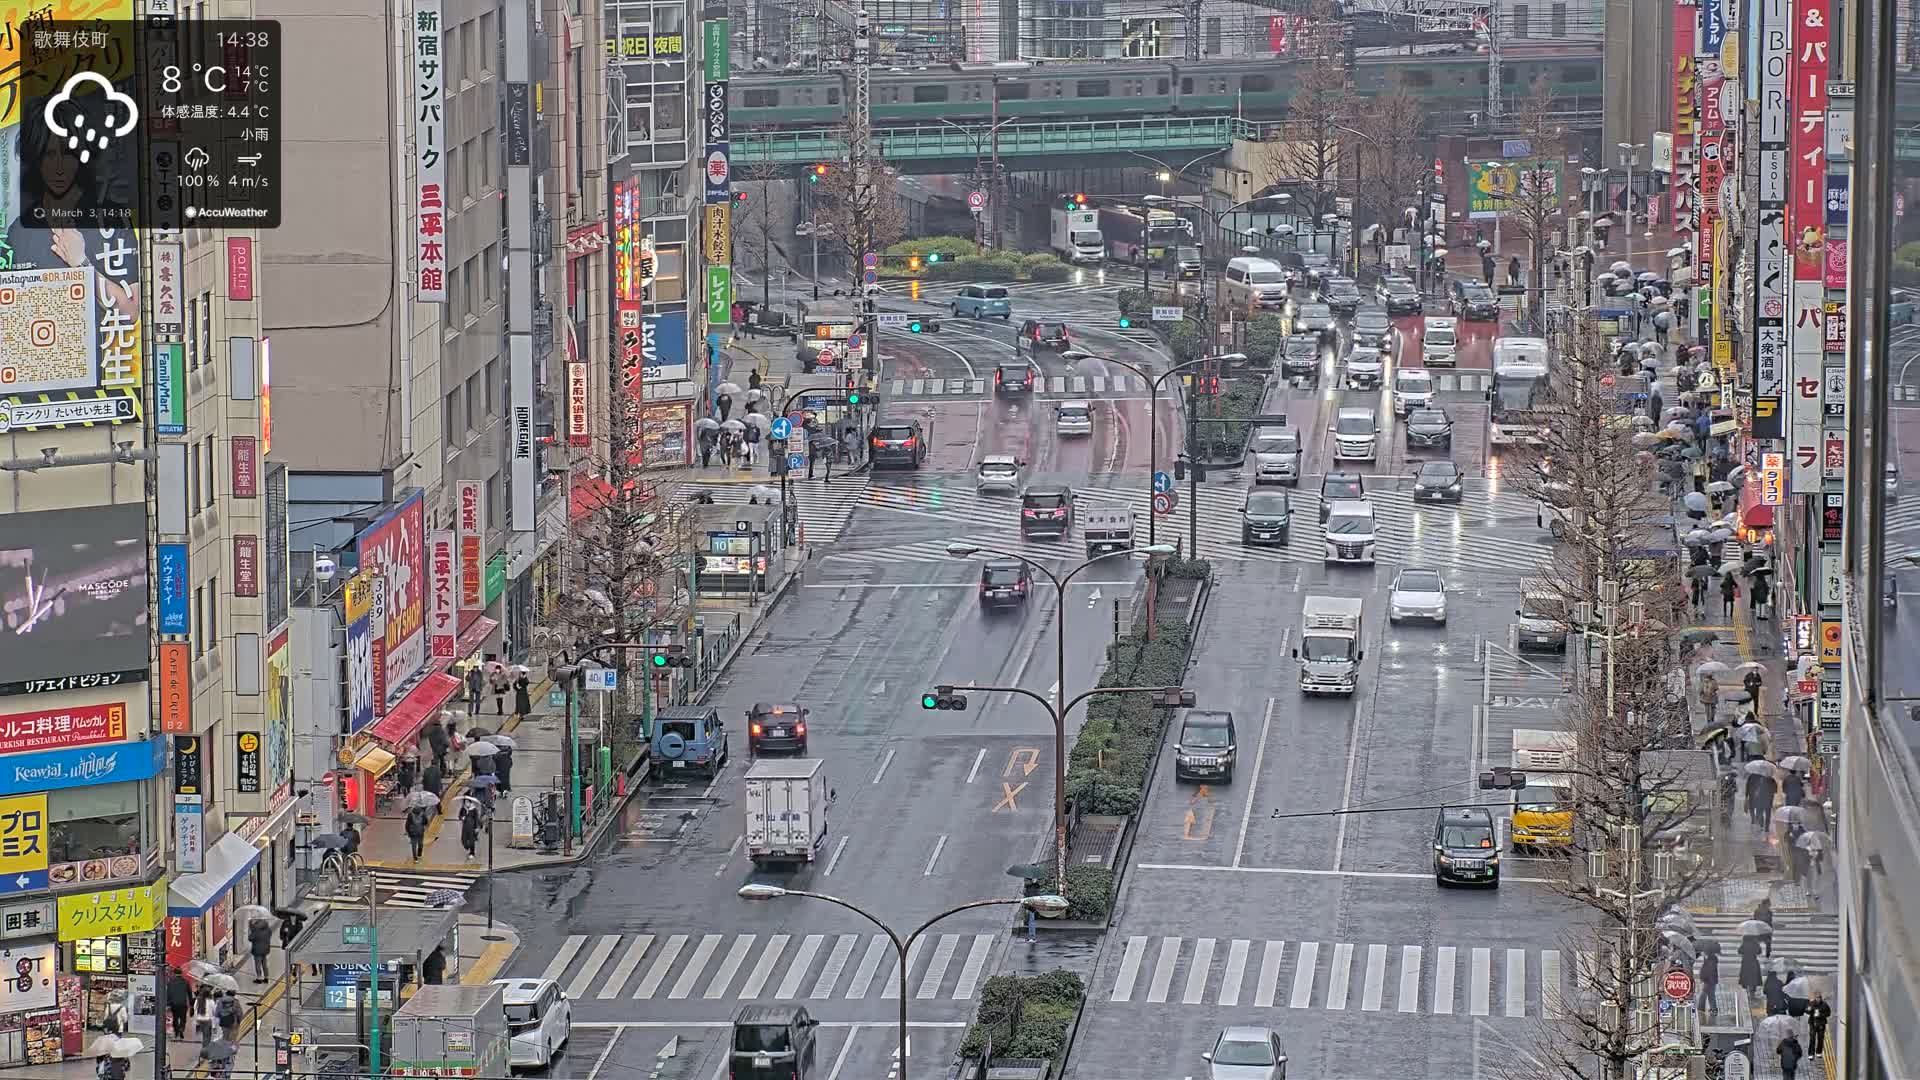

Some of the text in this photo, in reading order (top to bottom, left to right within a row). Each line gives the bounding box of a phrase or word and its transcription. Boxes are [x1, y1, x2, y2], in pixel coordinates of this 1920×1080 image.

[1707, 88, 1720, 118] アコム
[417, 10, 443, 291] 新宿サンパーク 三平本館
[709, 160, 727, 177] 薬
[712, 207, 726, 261] 肉汁水餃子
[1703, 229, 1711, 258] RESALE
[712, 275, 726, 312] レイク
[160, 324, 177, 333] 3F
[622, 330, 640, 388] ラーメン
[1761, 329, 1775, 381] 大衆酒場
[160, 353, 170, 413] FamilyMart
[1796, 308, 1822, 468] パセラ
[15, 404, 113, 421] テンクリ たいせい先生
[1830, 405, 1842, 413] 5F
[516, 407, 529, 458] HOMEGAME
[463, 487, 472, 530] GAME
[1829, 496, 1841, 505] 3F
[715, 541, 727, 551] 10
[163, 554, 174, 604] ゲウチャイ
[239, 547, 252, 582] 龍生堂
[375, 581, 383, 618] 389
[435, 542, 451, 628] 三平ストア
[112, 710, 120, 735] 5F
[27, 735, 70, 746] RESTAURANT
[2, 809, 41, 835] プロ
[3, 834, 41, 857] ミス
[6, 910, 41, 930] 囲碁
[72, 902, 144, 926] クリスタル
[329, 990, 344, 1003] 12
